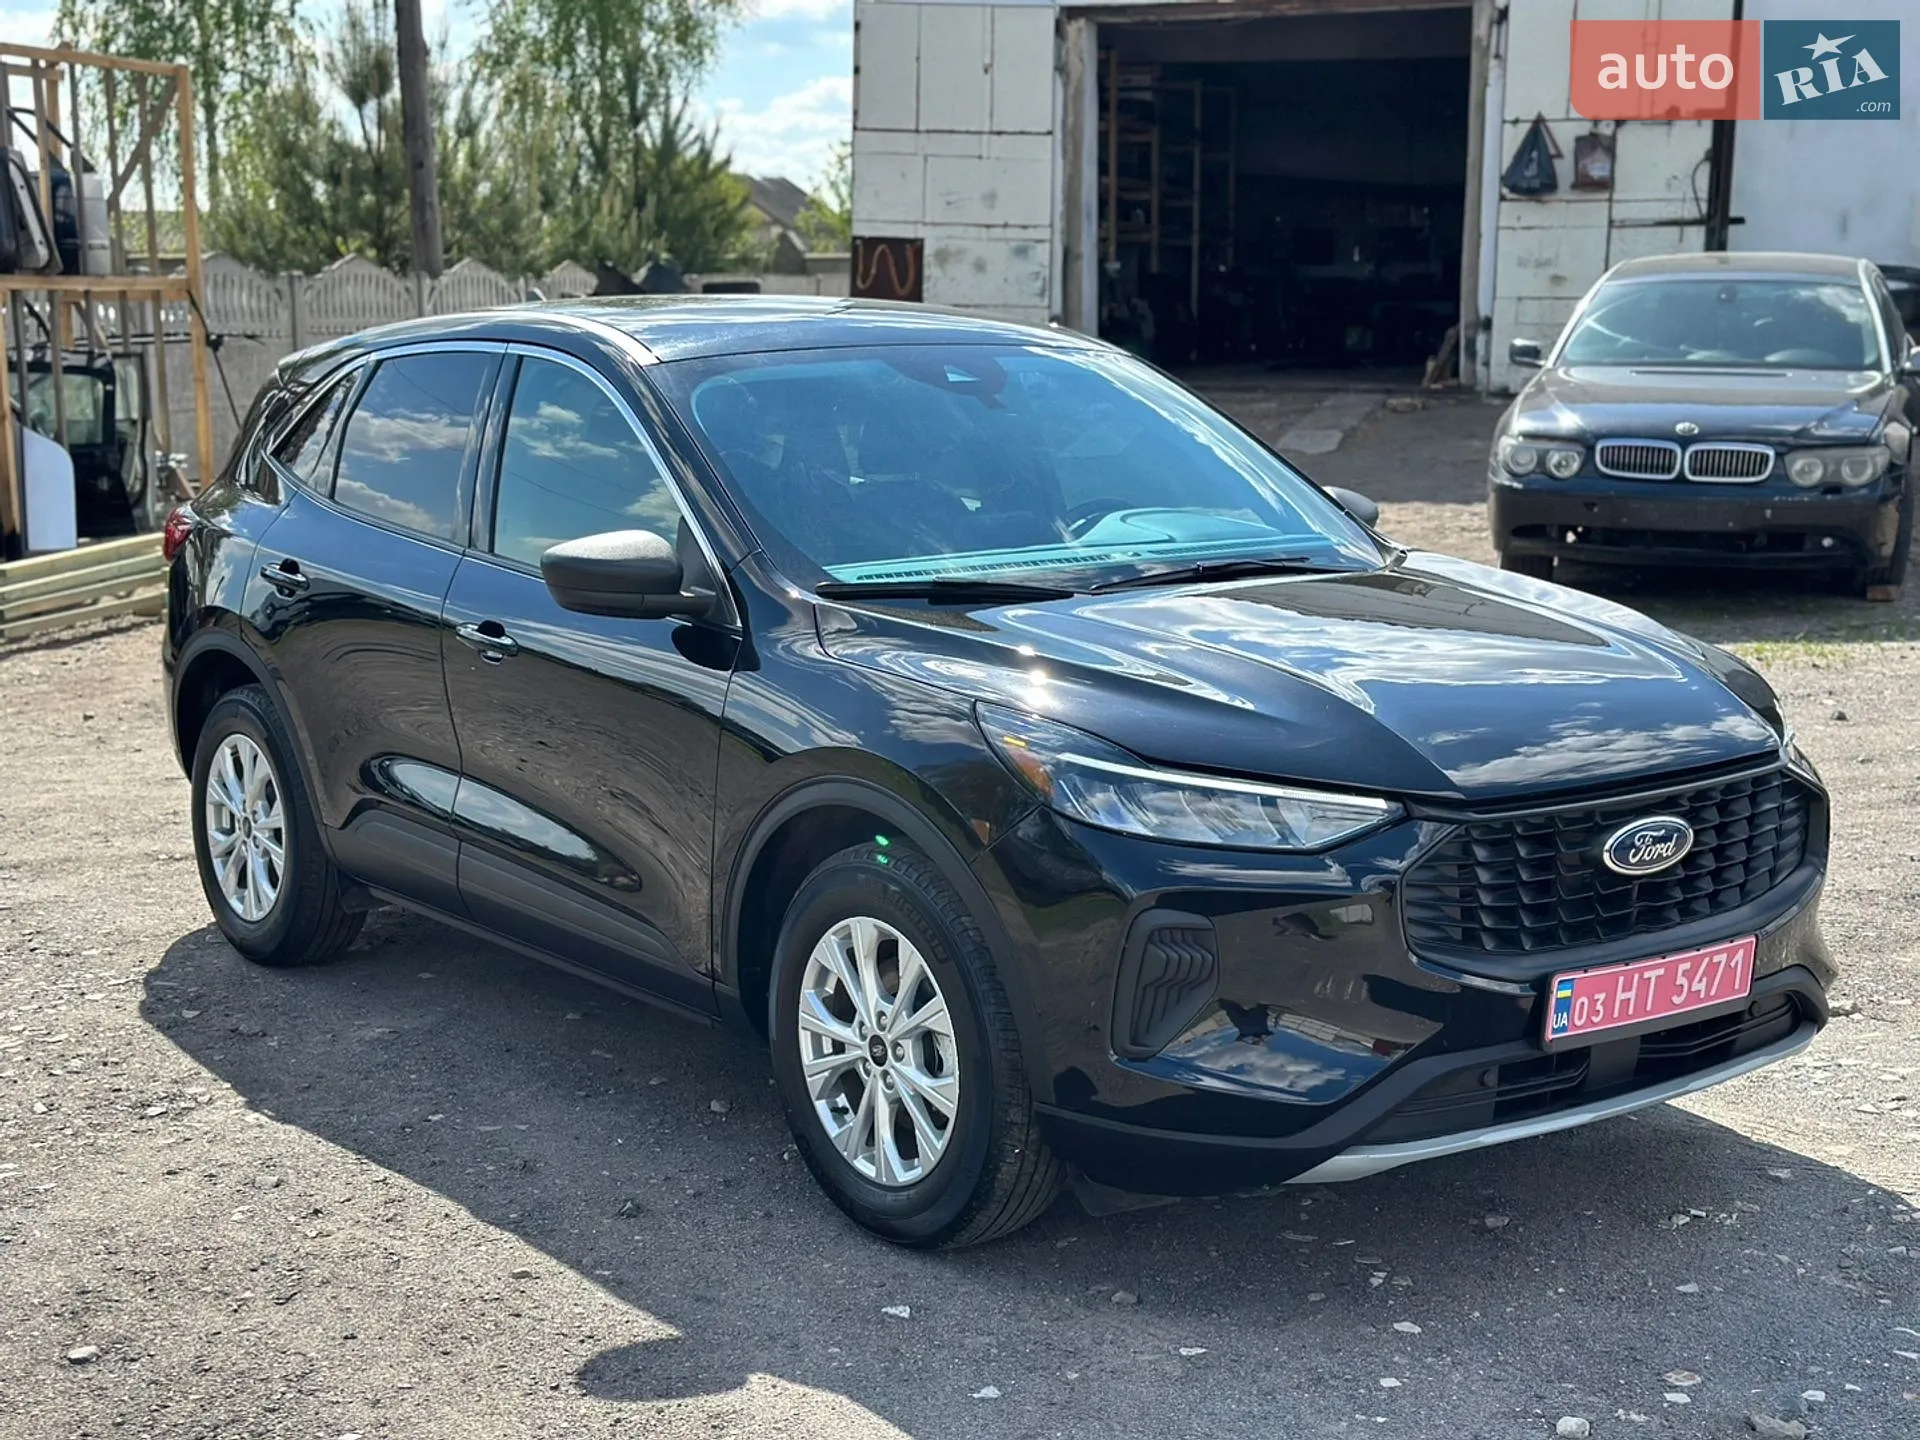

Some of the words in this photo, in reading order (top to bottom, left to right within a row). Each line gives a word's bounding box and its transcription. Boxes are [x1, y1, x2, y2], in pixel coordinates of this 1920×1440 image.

[1629, 829, 1678, 864] Ford
[1573, 992, 1607, 1028] 03
[1612, 967, 1665, 1019] HT
[1671, 948, 1745, 1006] 5471
[1553, 1011, 1568, 1029] UA
